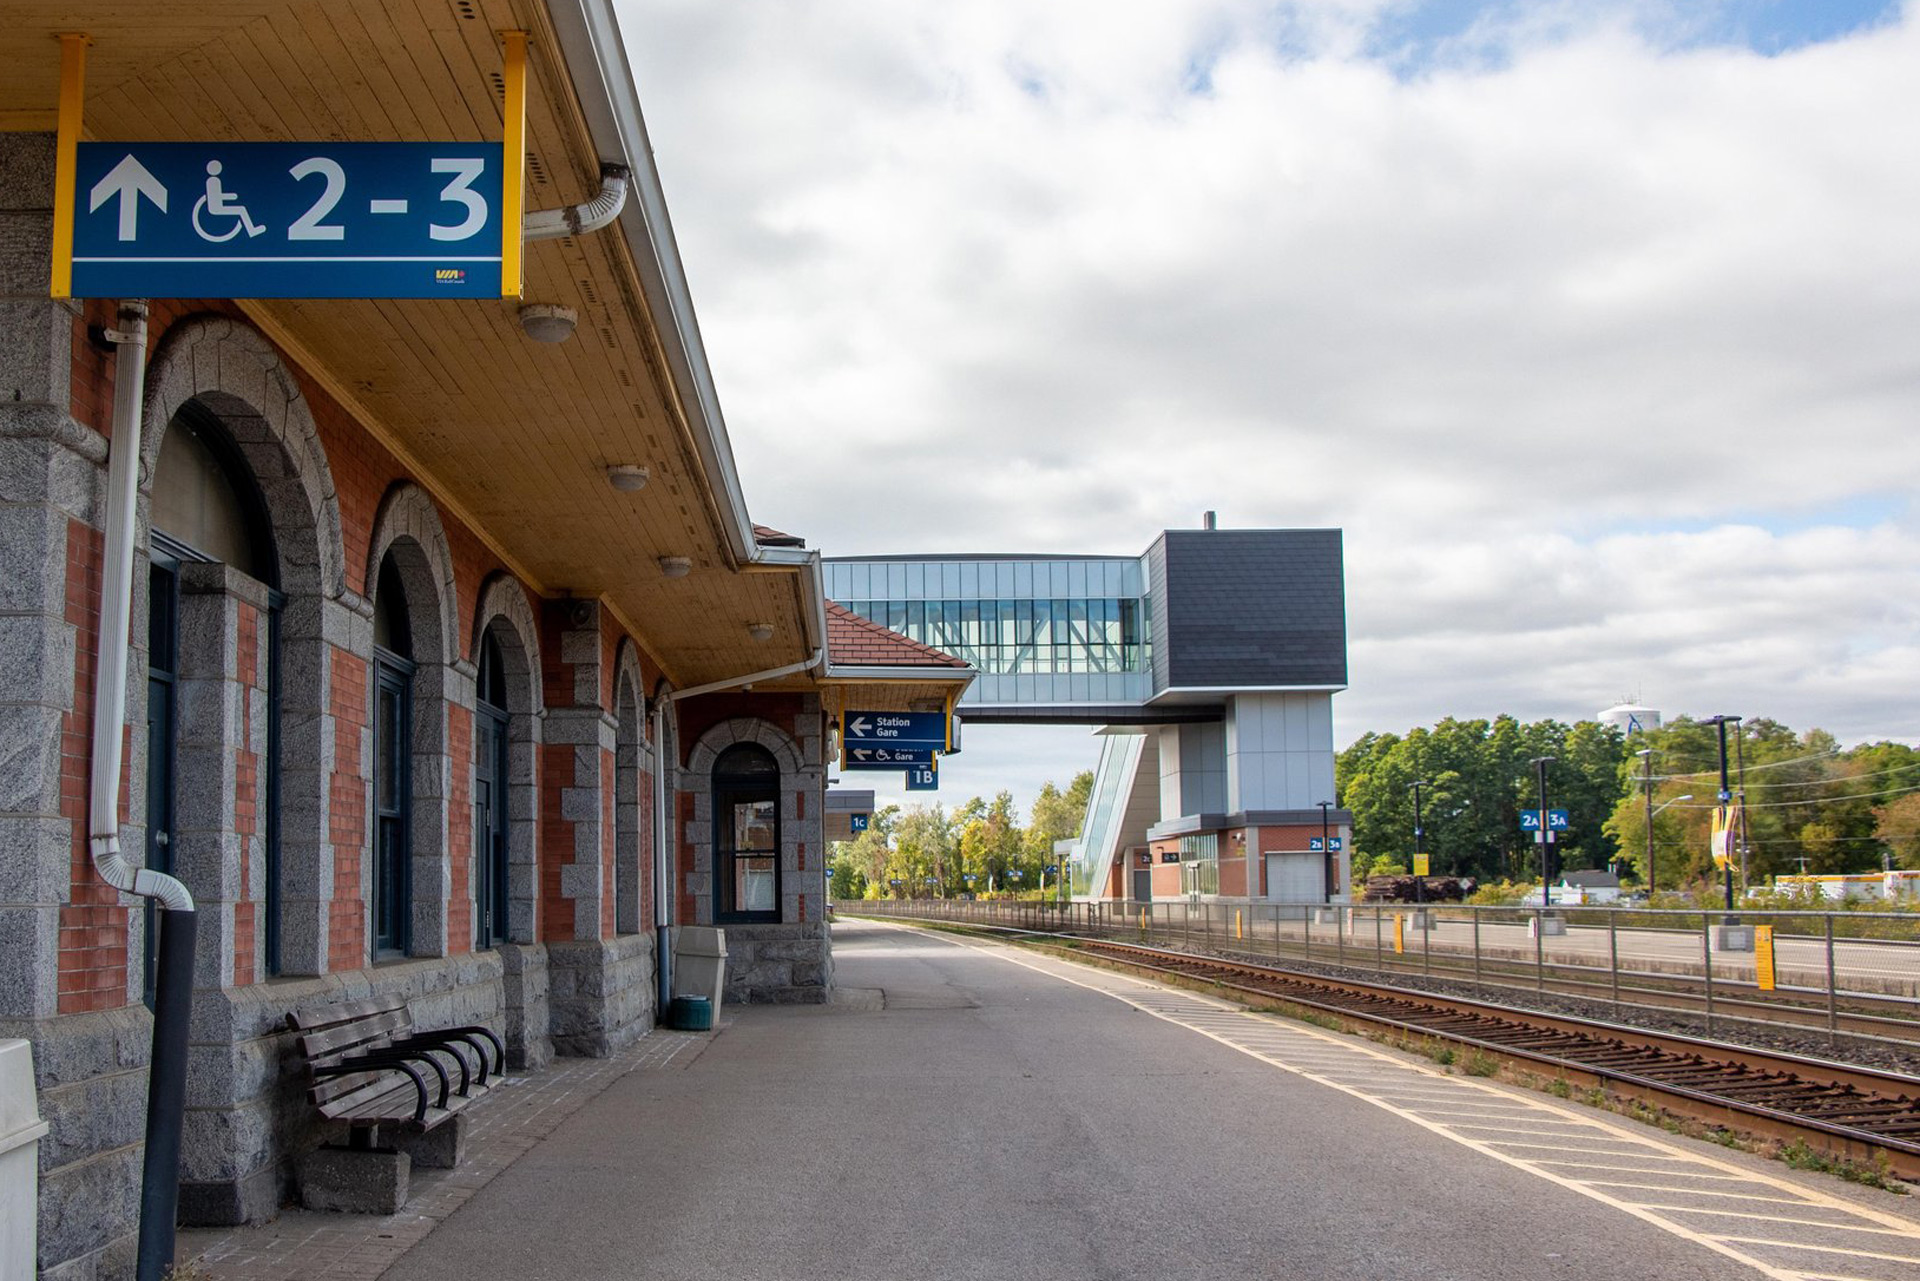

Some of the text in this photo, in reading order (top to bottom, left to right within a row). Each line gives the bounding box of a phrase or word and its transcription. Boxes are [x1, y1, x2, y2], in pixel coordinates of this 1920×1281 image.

[287, 157, 347, 241] 2
[429, 158, 489, 242] 3
[876, 717, 911, 727] Station
[876, 728, 899, 737] Gare
[894, 752, 914, 761] Gare
[912, 770, 933, 784] 1B
[1522, 814, 1539, 827] 2A
[1550, 813, 1566, 826] 3A
